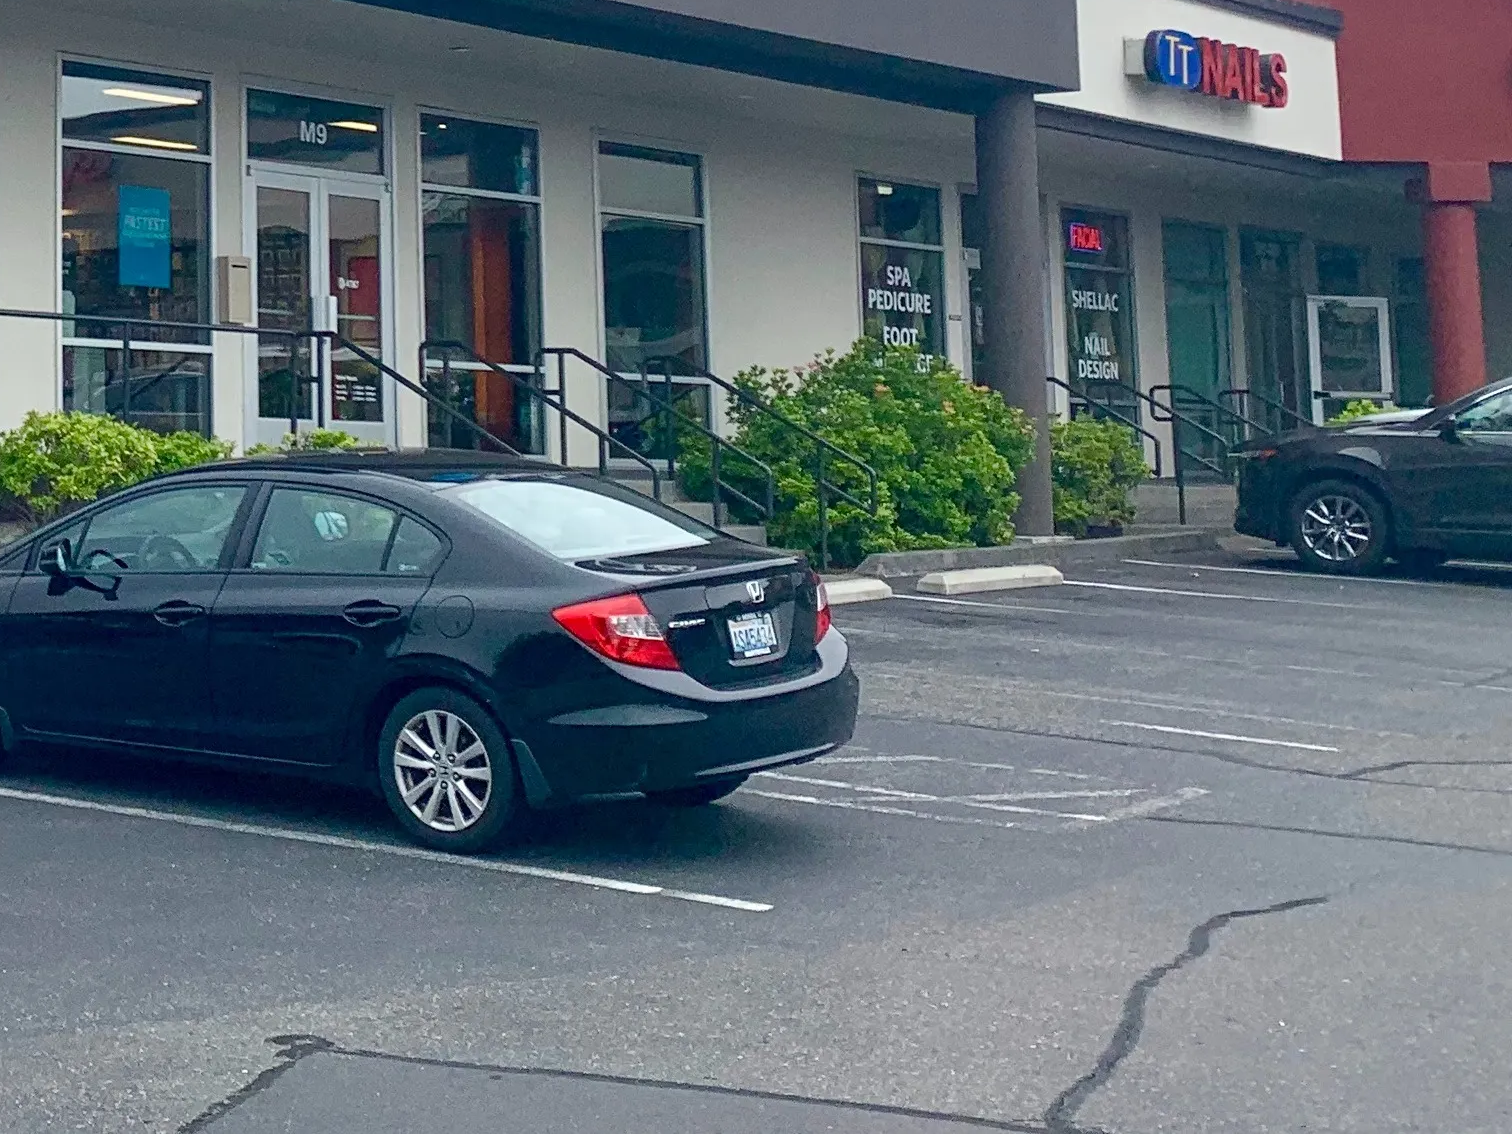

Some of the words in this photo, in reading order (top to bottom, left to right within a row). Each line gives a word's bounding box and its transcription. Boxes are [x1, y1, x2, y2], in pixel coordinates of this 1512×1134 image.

[1200, 37, 1288, 108] NAILS
[300, 120, 327, 145] M9
[886, 265, 912, 287] SPA
[868, 288, 932, 314] PEDICURE
[1071, 289, 1119, 312] SHELLAC
[883, 325, 919, 346] FOOT
[1084, 335, 1111, 356] NAIL
[1078, 359, 1119, 381] DESIGN
